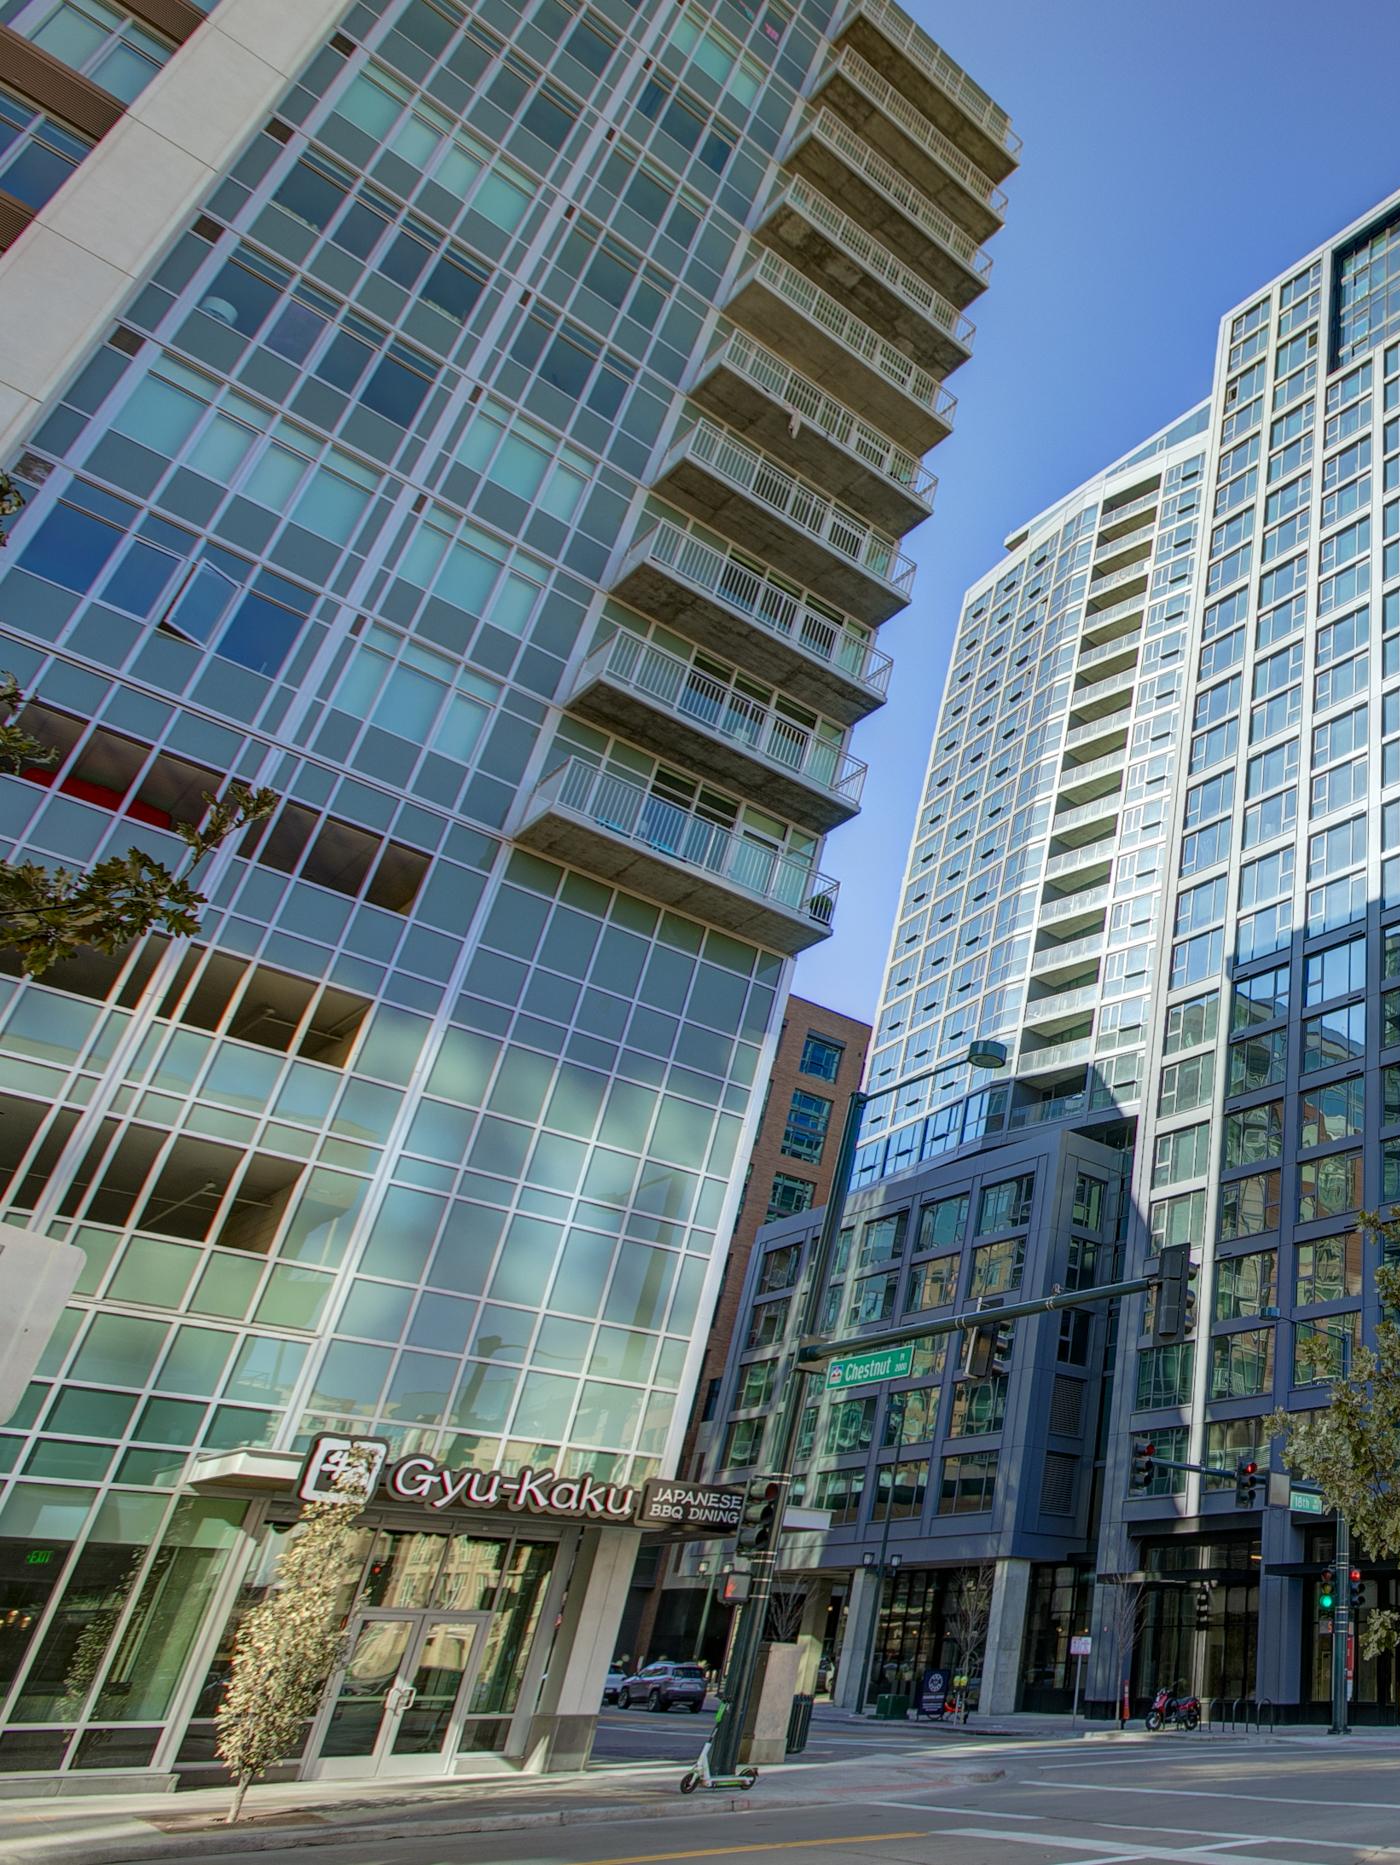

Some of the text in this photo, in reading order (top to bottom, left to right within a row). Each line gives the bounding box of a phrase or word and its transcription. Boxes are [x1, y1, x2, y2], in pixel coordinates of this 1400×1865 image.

[845, 1357, 891, 1381] Chestnut
[394, 1457, 634, 1515] Gyu-Kaku
[652, 1487, 743, 1510] JAPANESE
[649, 1503, 741, 1524] BBQ DINING
